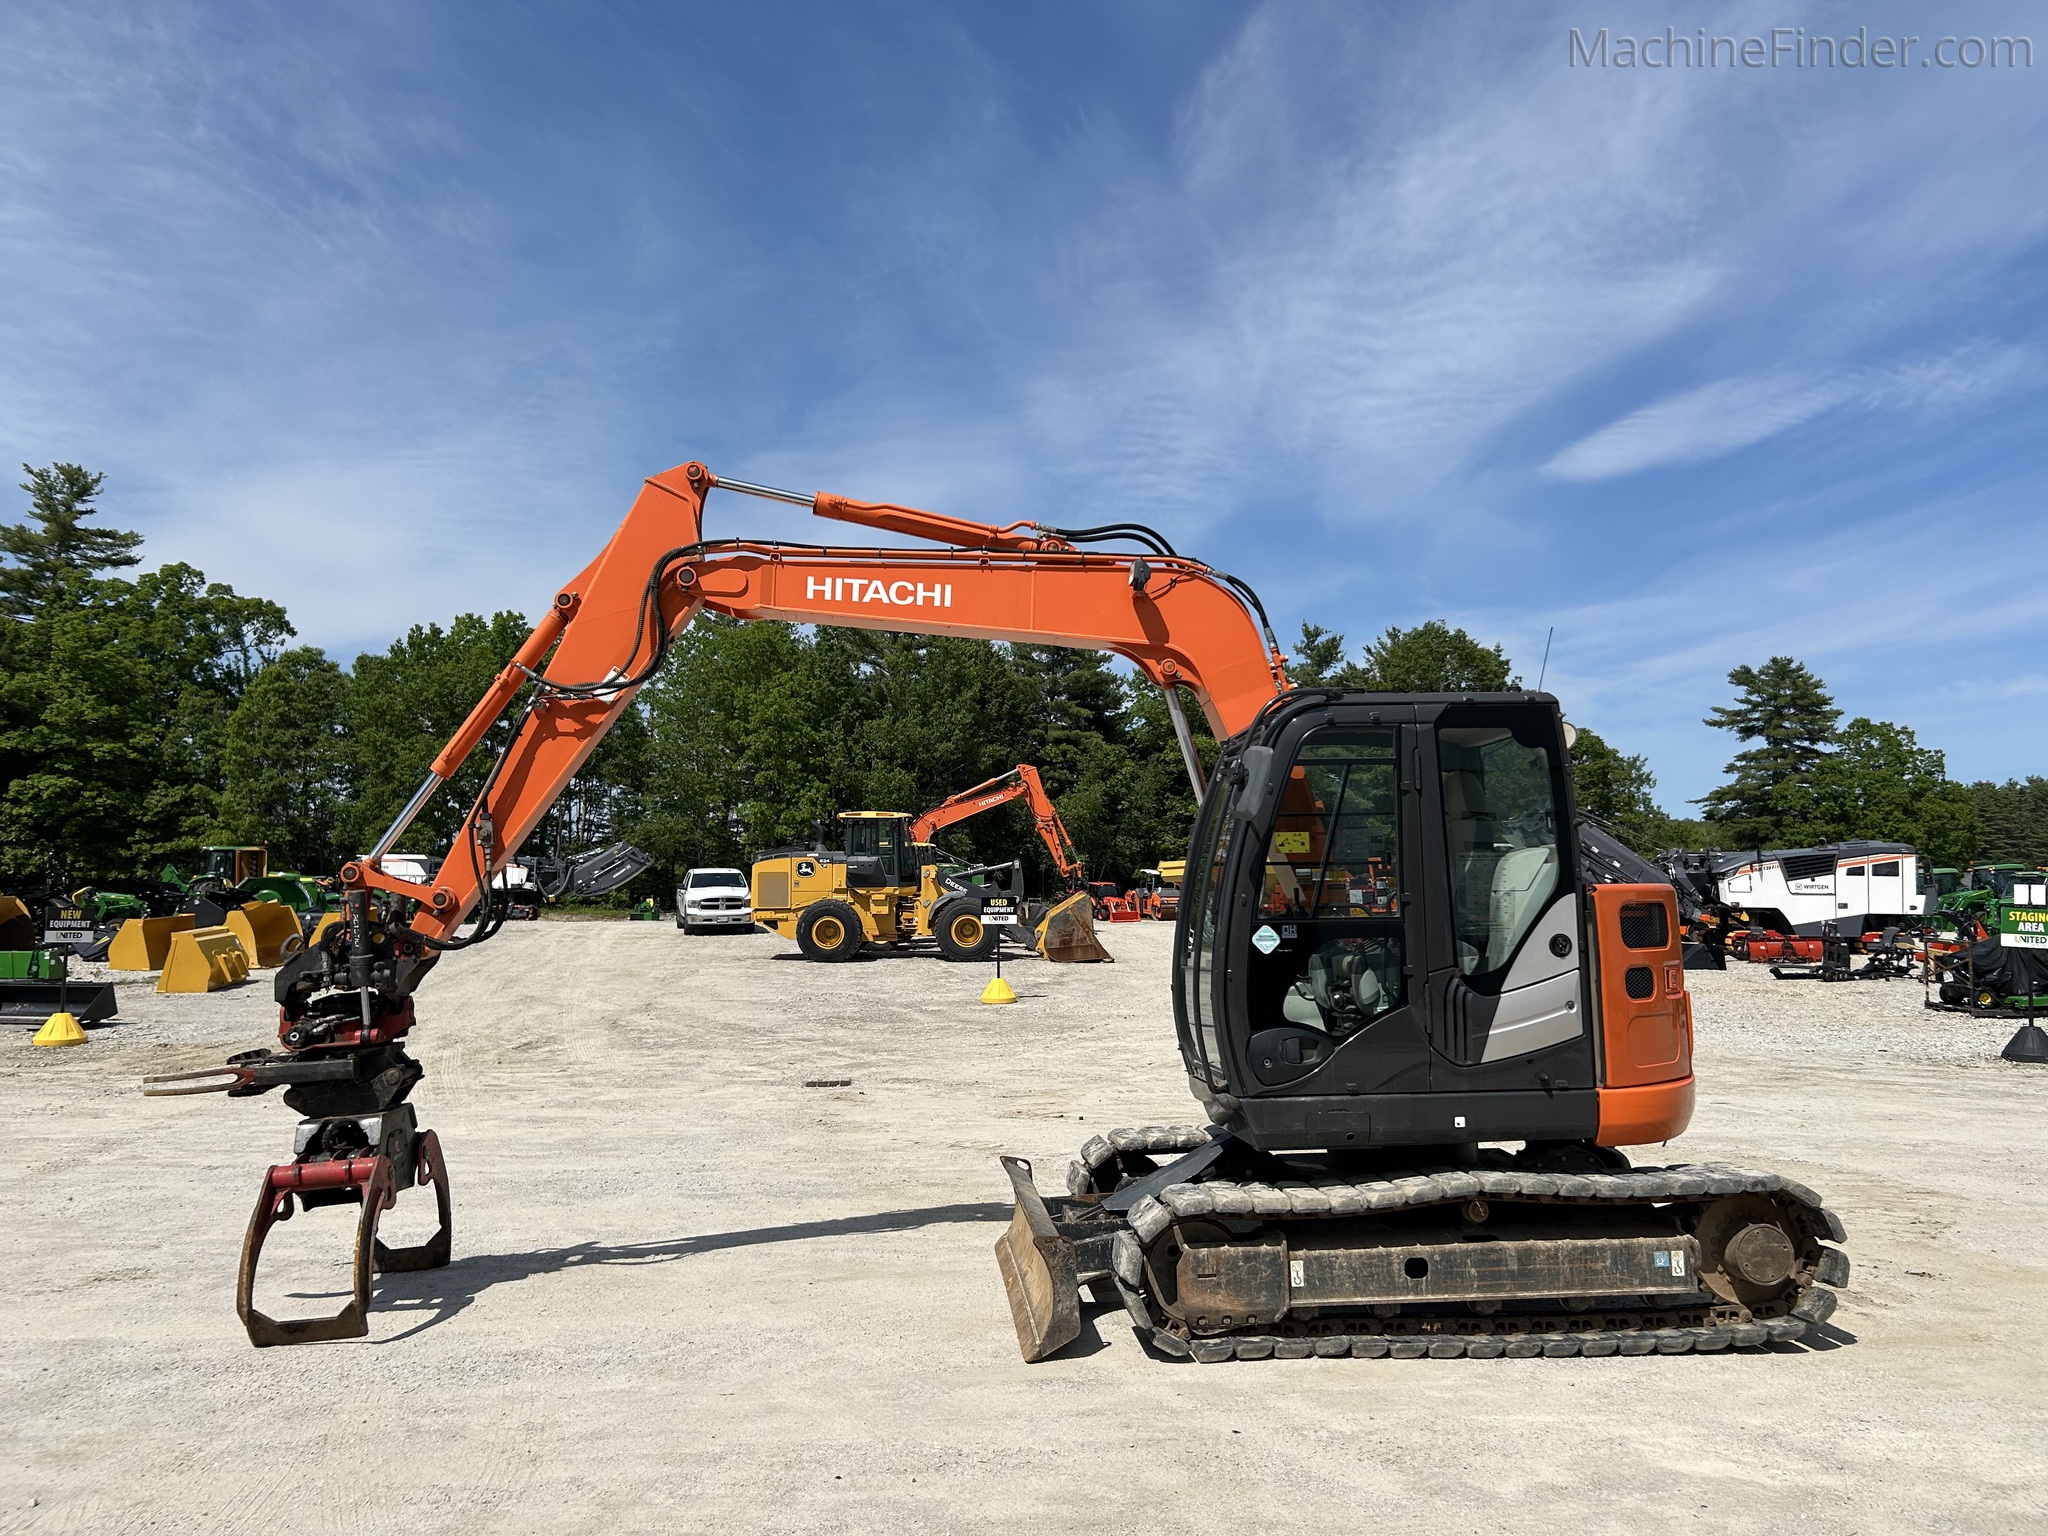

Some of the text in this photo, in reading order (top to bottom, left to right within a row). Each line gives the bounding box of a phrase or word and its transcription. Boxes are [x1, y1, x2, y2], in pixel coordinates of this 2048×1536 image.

[806, 575, 952, 607] HITACHI
[978, 793, 1005, 807] HITACHI
[944, 877, 969, 894] DEERE
[60, 909, 82, 919] NEW
[49, 920, 91, 928] EQUIPMENT
[2017, 922, 2045, 932] AREA
[2014, 935, 2047, 944] UNITED
